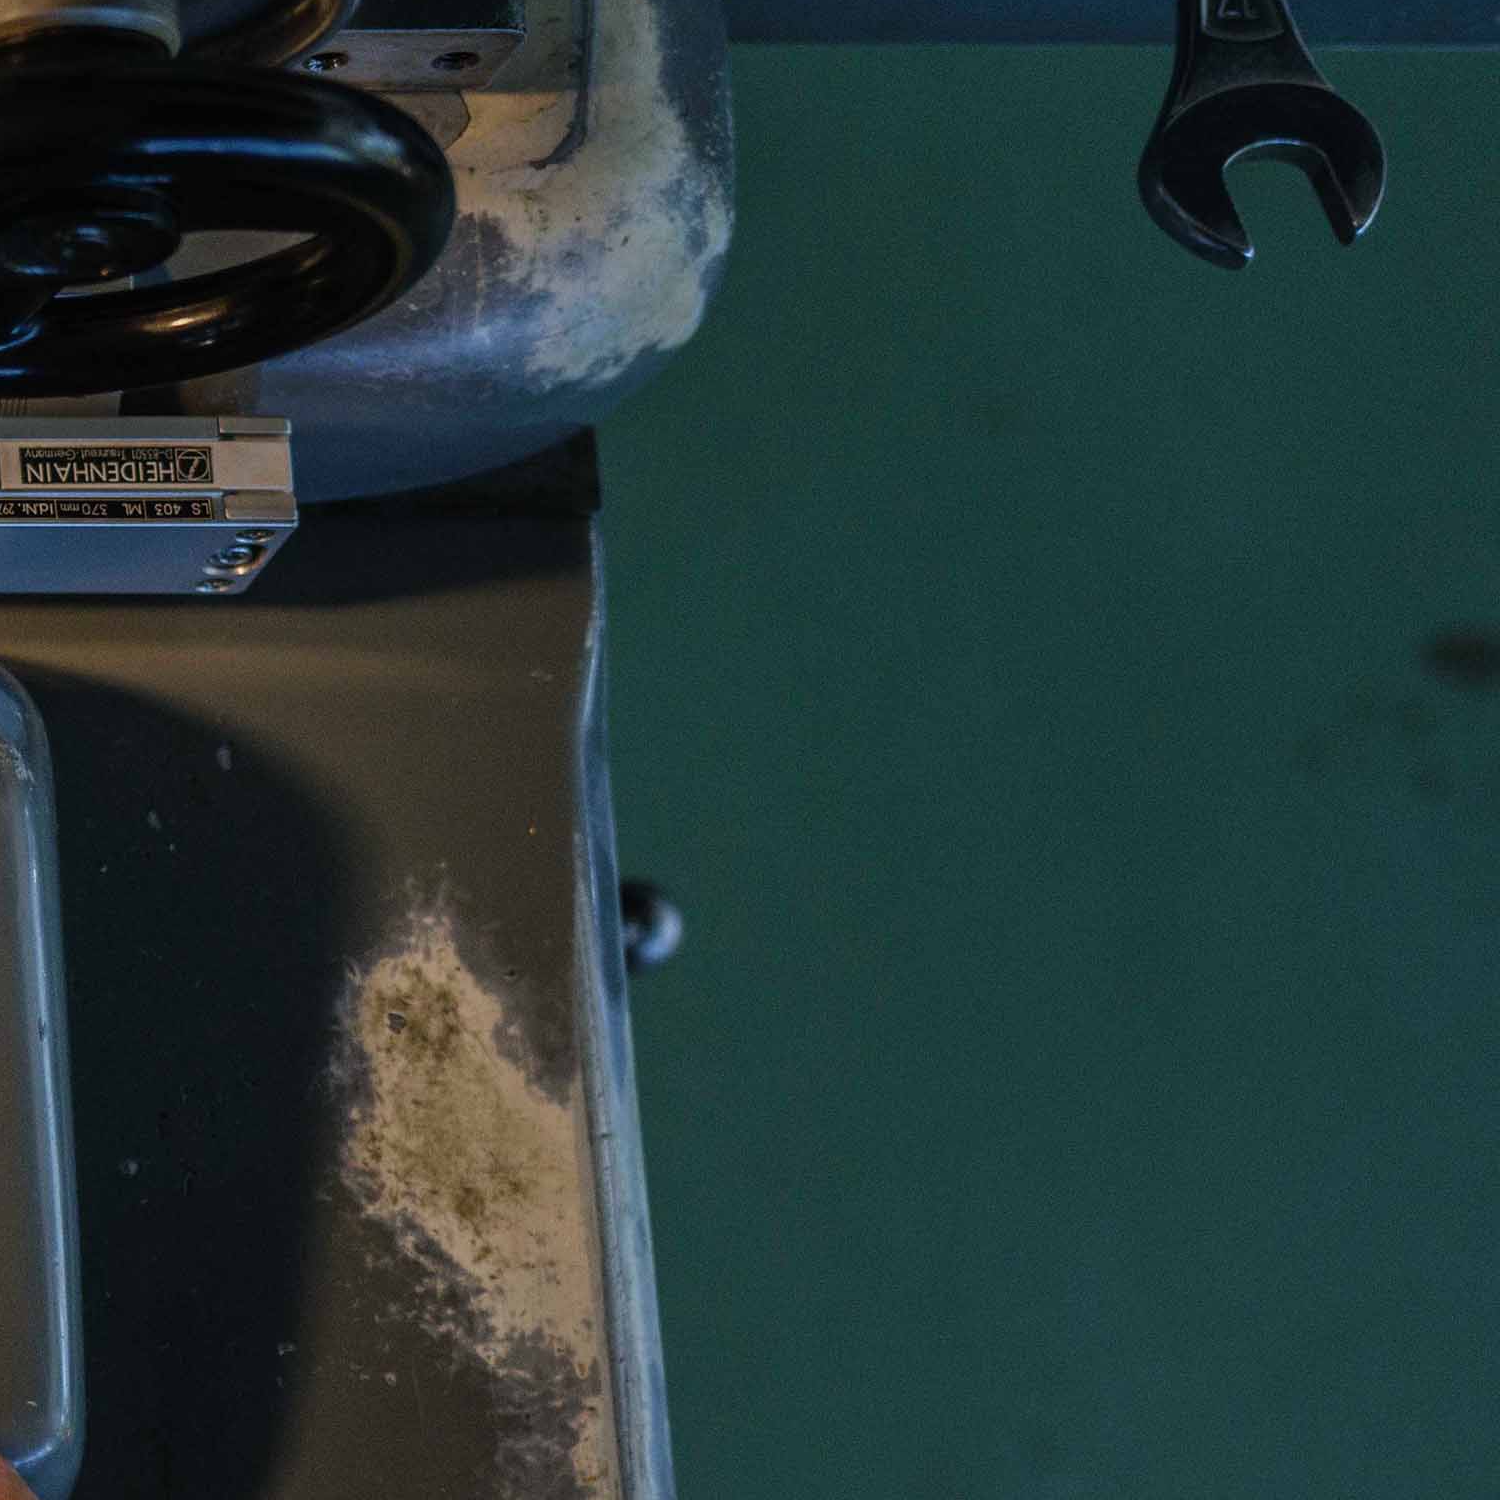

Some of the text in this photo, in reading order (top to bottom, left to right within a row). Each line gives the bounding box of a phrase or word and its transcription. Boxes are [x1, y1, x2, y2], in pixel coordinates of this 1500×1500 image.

[25, 462, 174, 483] HEIDENHAIN
[60, 503, 81, 514] mm
[82, 502, 108, 515] 370
[121, 502, 142, 515] ML
[155, 502, 181, 515] 403
[191, 502, 209, 515] LS
